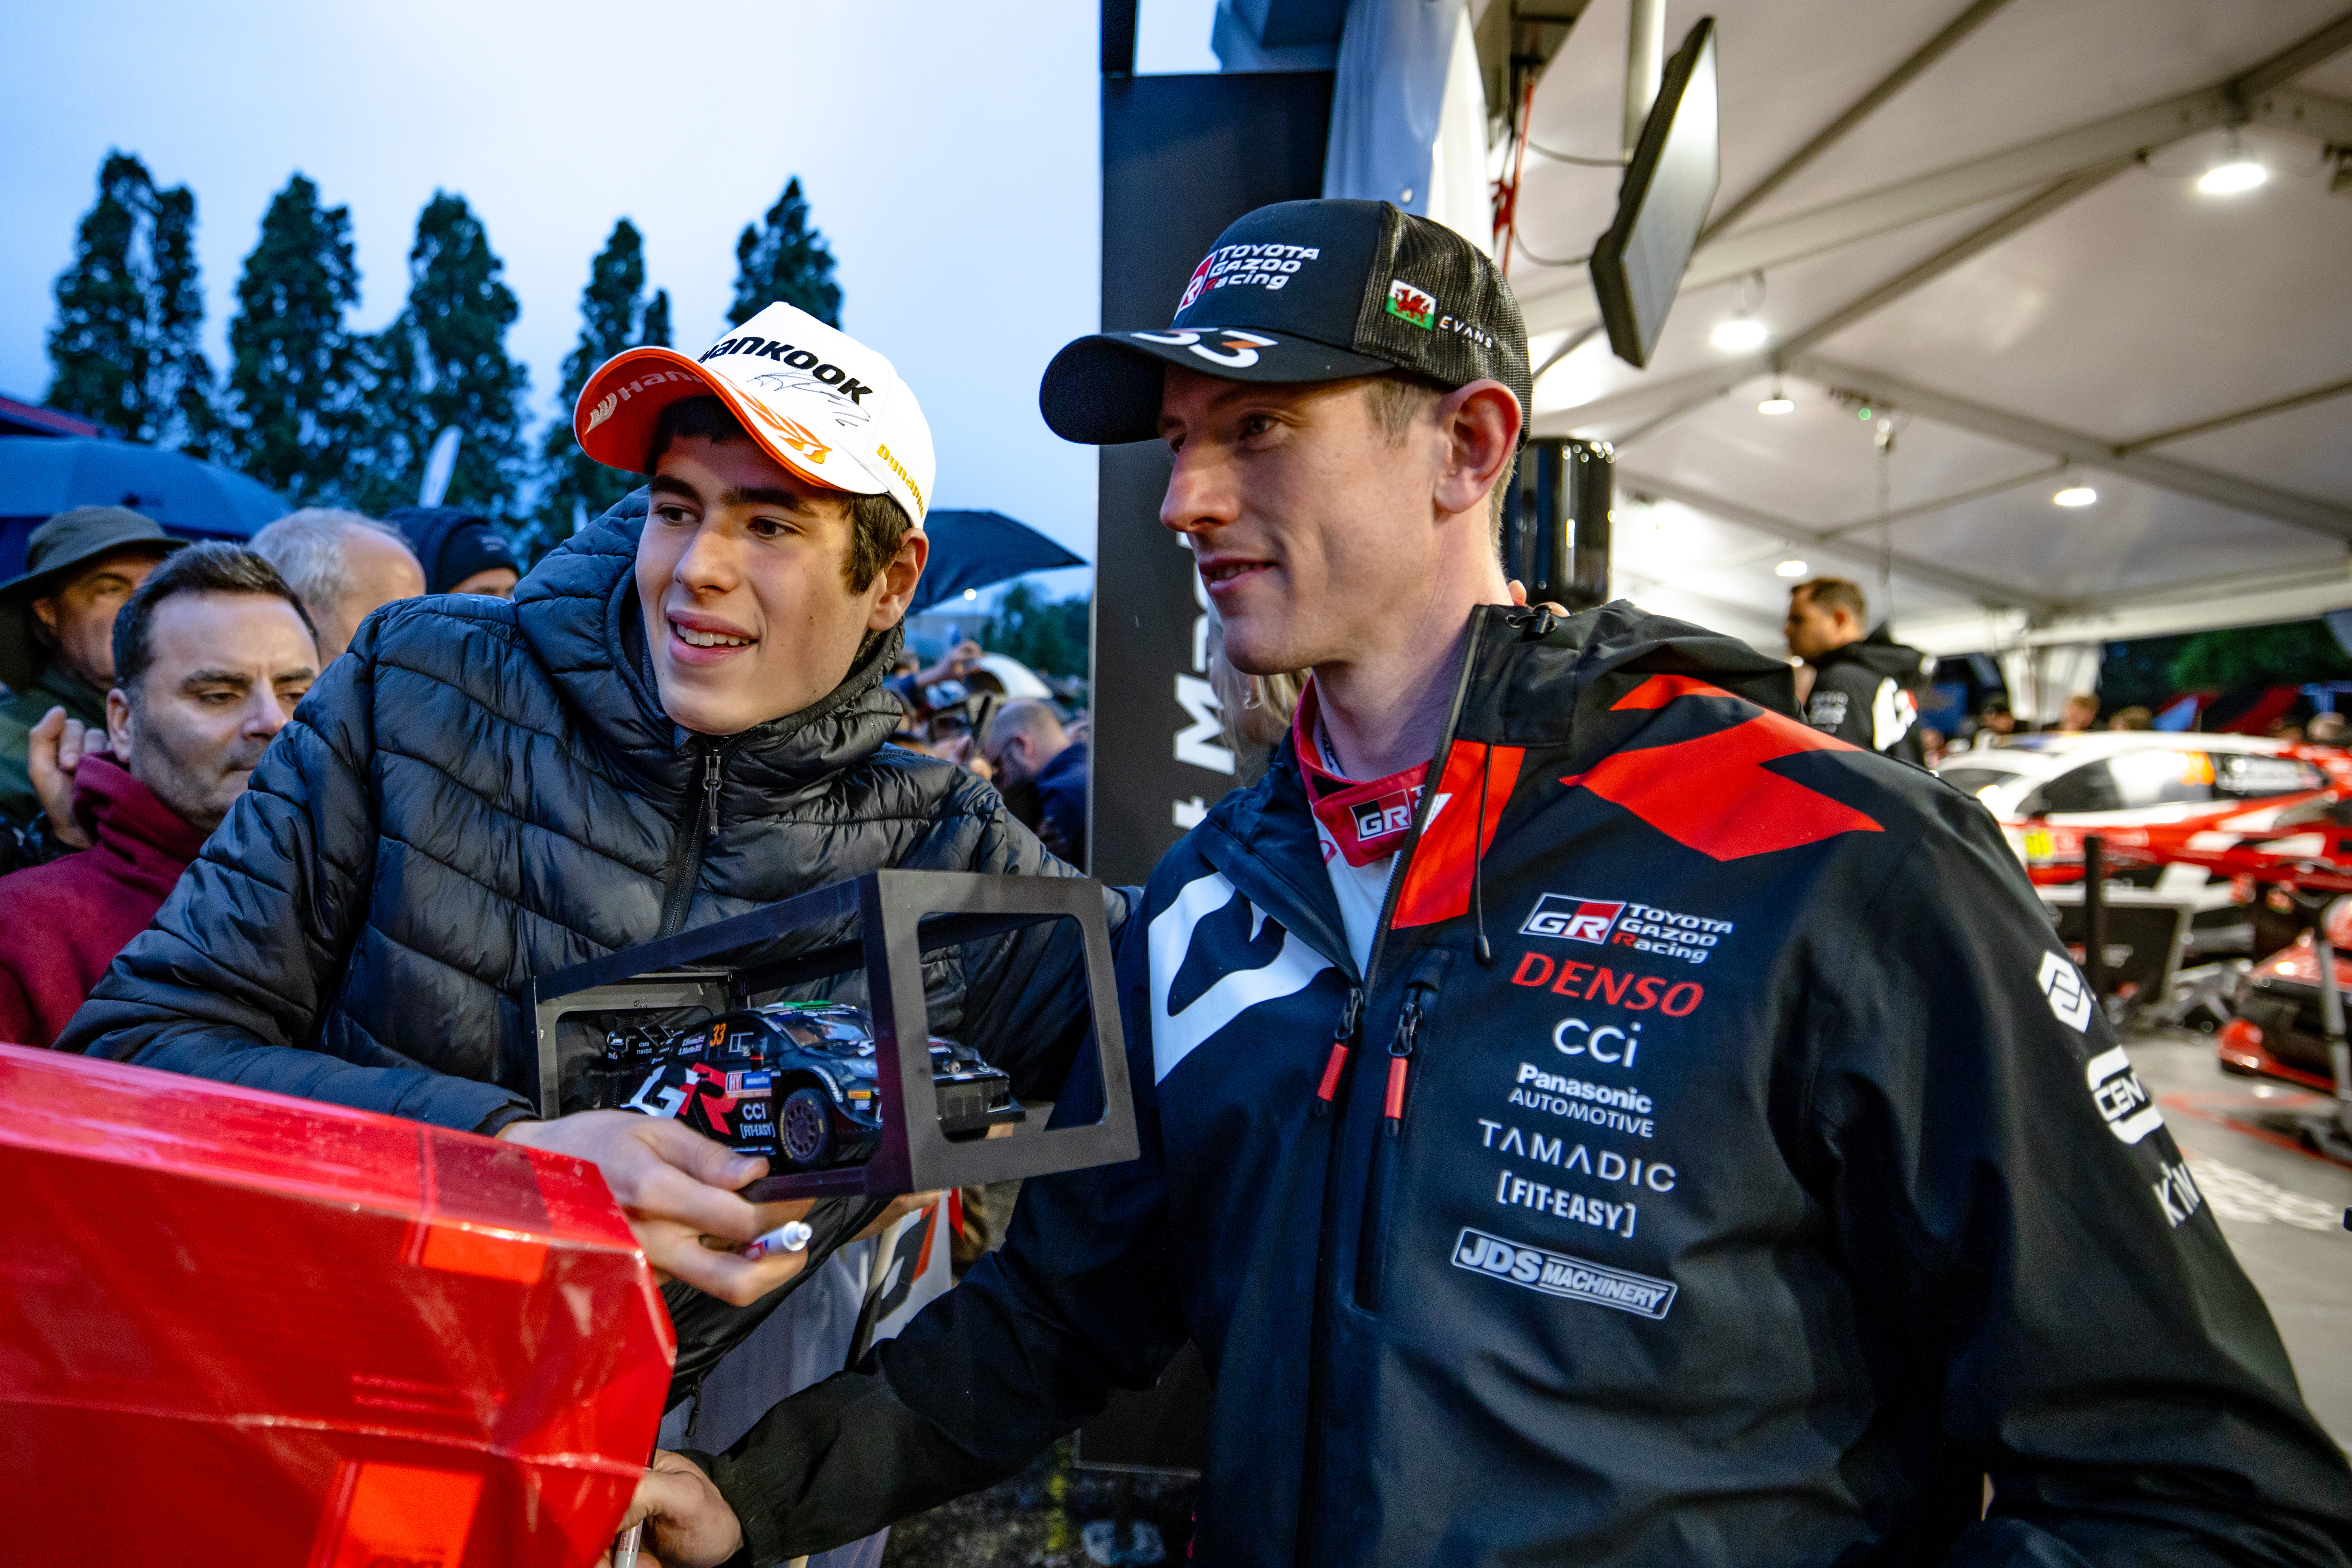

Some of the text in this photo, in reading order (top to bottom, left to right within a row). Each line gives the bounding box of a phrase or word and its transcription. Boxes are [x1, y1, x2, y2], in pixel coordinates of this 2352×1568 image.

[1209, 258, 1301, 278] GAZOO
[1219, 244, 1320, 262] TOYOTA
[1200, 270, 1289, 295] Racing
[1439, 316, 1492, 348] EVANS
[1359, 805, 1408, 836] GR
[1528, 903, 1734, 942] GR TOYOTA
[1618, 917, 1718, 947] GAZOO
[1613, 932, 1710, 964] Racing
[1511, 952, 1705, 1017] DENSO
[709, 1022, 727, 1047] 33
[1518, 1062, 1653, 1114] Panasonic
[2094, 1071, 2145, 1122] CEN
[1508, 1087, 1654, 1138] AUTOMOTIVE
[1478, 1118, 1677, 1192] TAMADIC
[1459, 1238, 1667, 1309] JDS MACHINERY
[619, 1532, 627, 1552] SUPE
